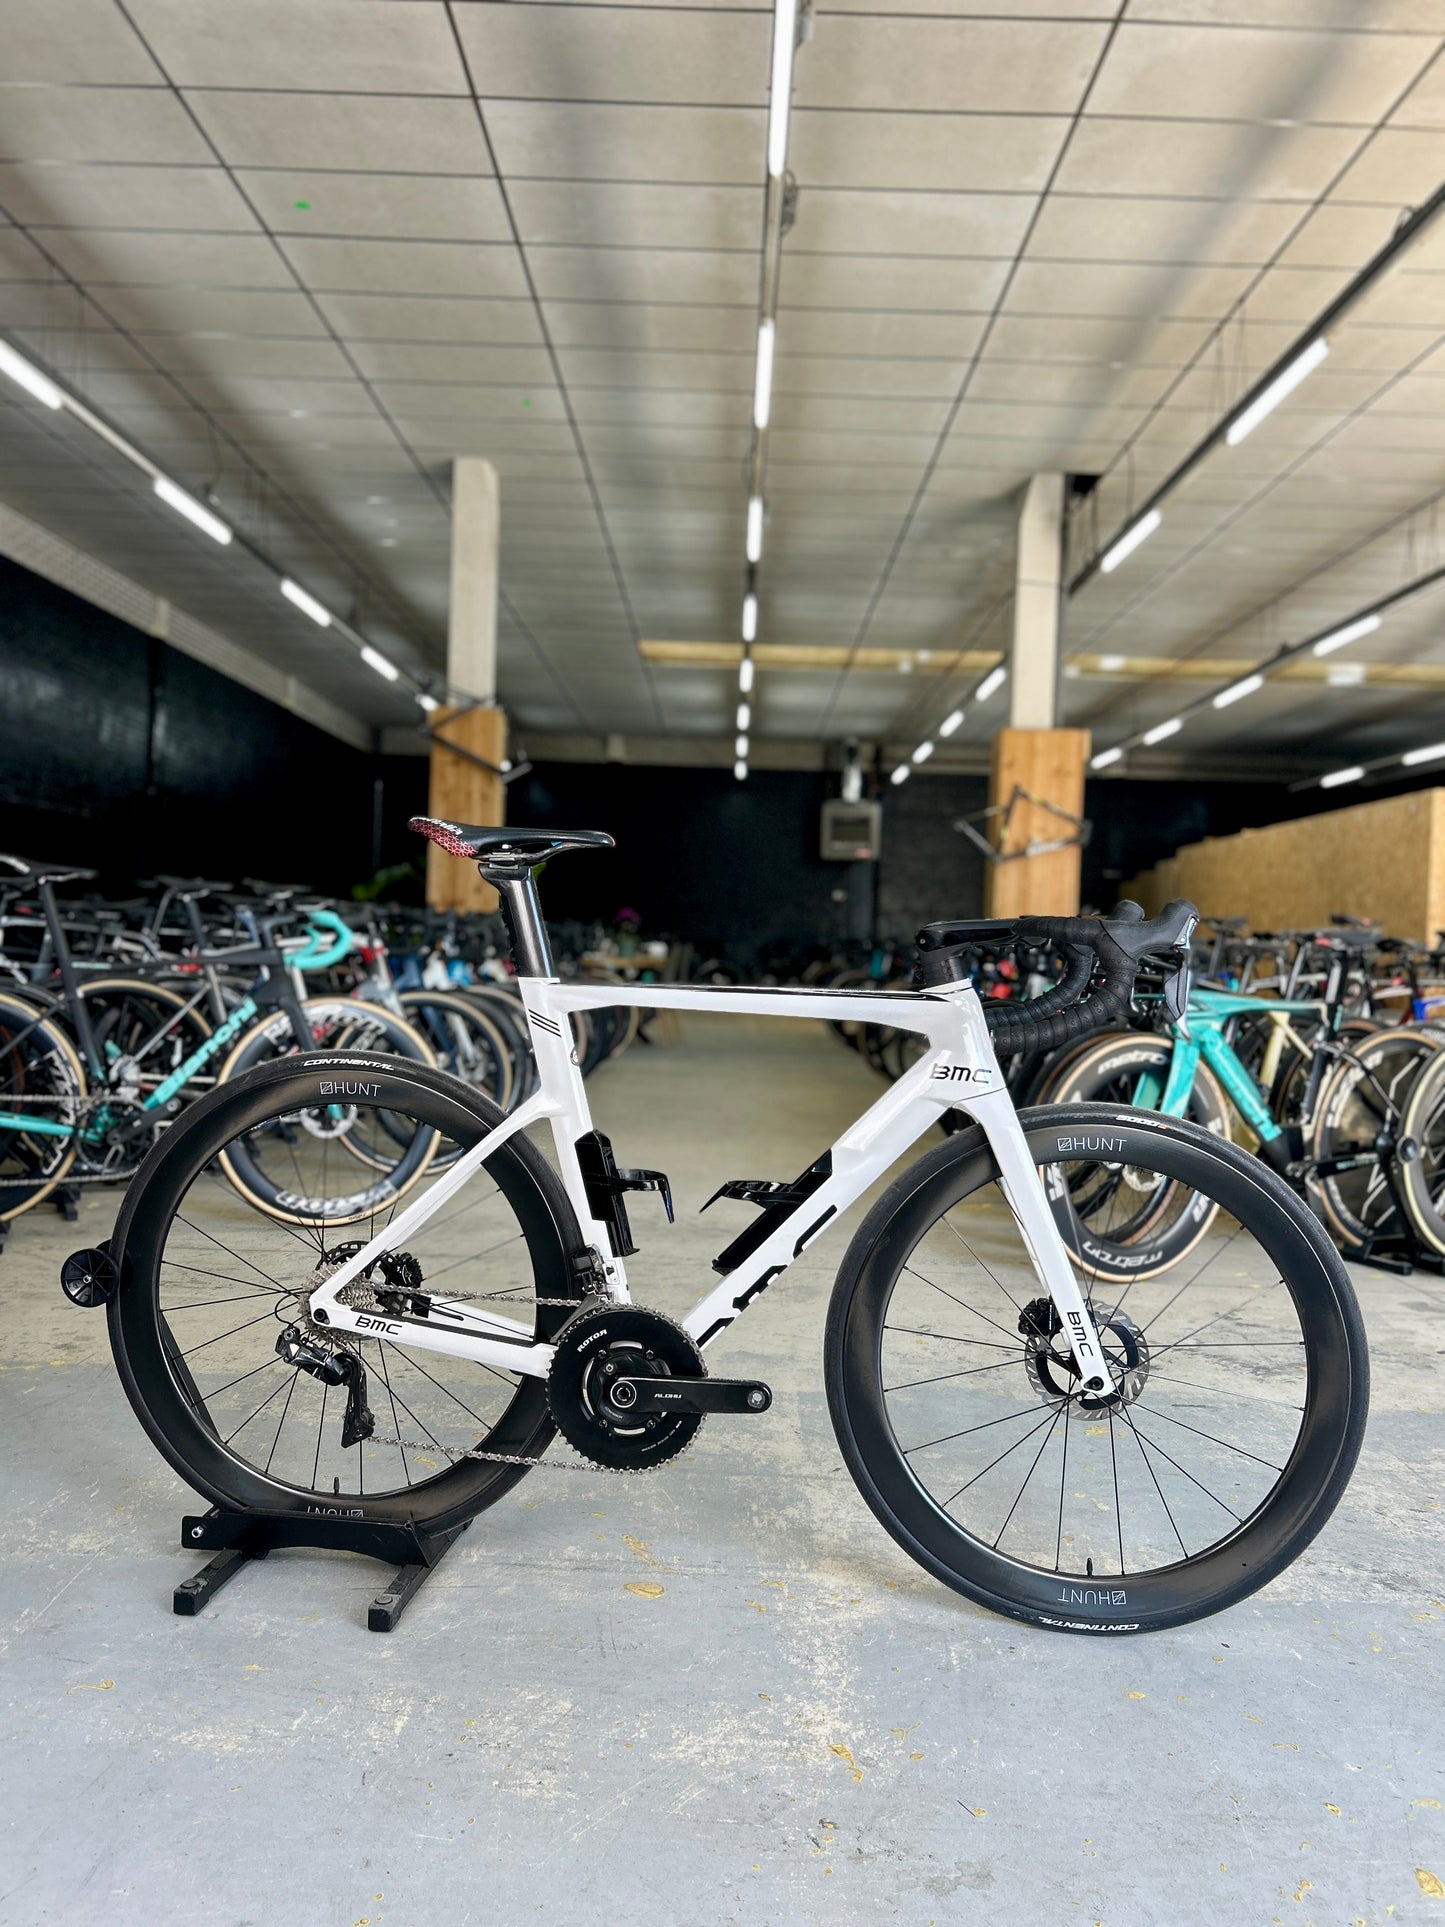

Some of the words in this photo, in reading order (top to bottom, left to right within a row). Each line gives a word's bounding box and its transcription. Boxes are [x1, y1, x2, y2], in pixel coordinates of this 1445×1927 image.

[303, 1058, 395, 1071] CONTINENTAL
[929, 1063, 993, 1084] BMC
[333, 1081, 382, 1097] HUNT
[1073, 1137, 1128, 1152] HUNT
[354, 1314, 403, 1335] BMC
[1066, 1311, 1094, 1357] BMC
[576, 1329, 608, 1353] ROTOR
[1057, 1587, 1111, 1606] HUNT
[1038, 1616, 1140, 1631] CONTINENTAL
